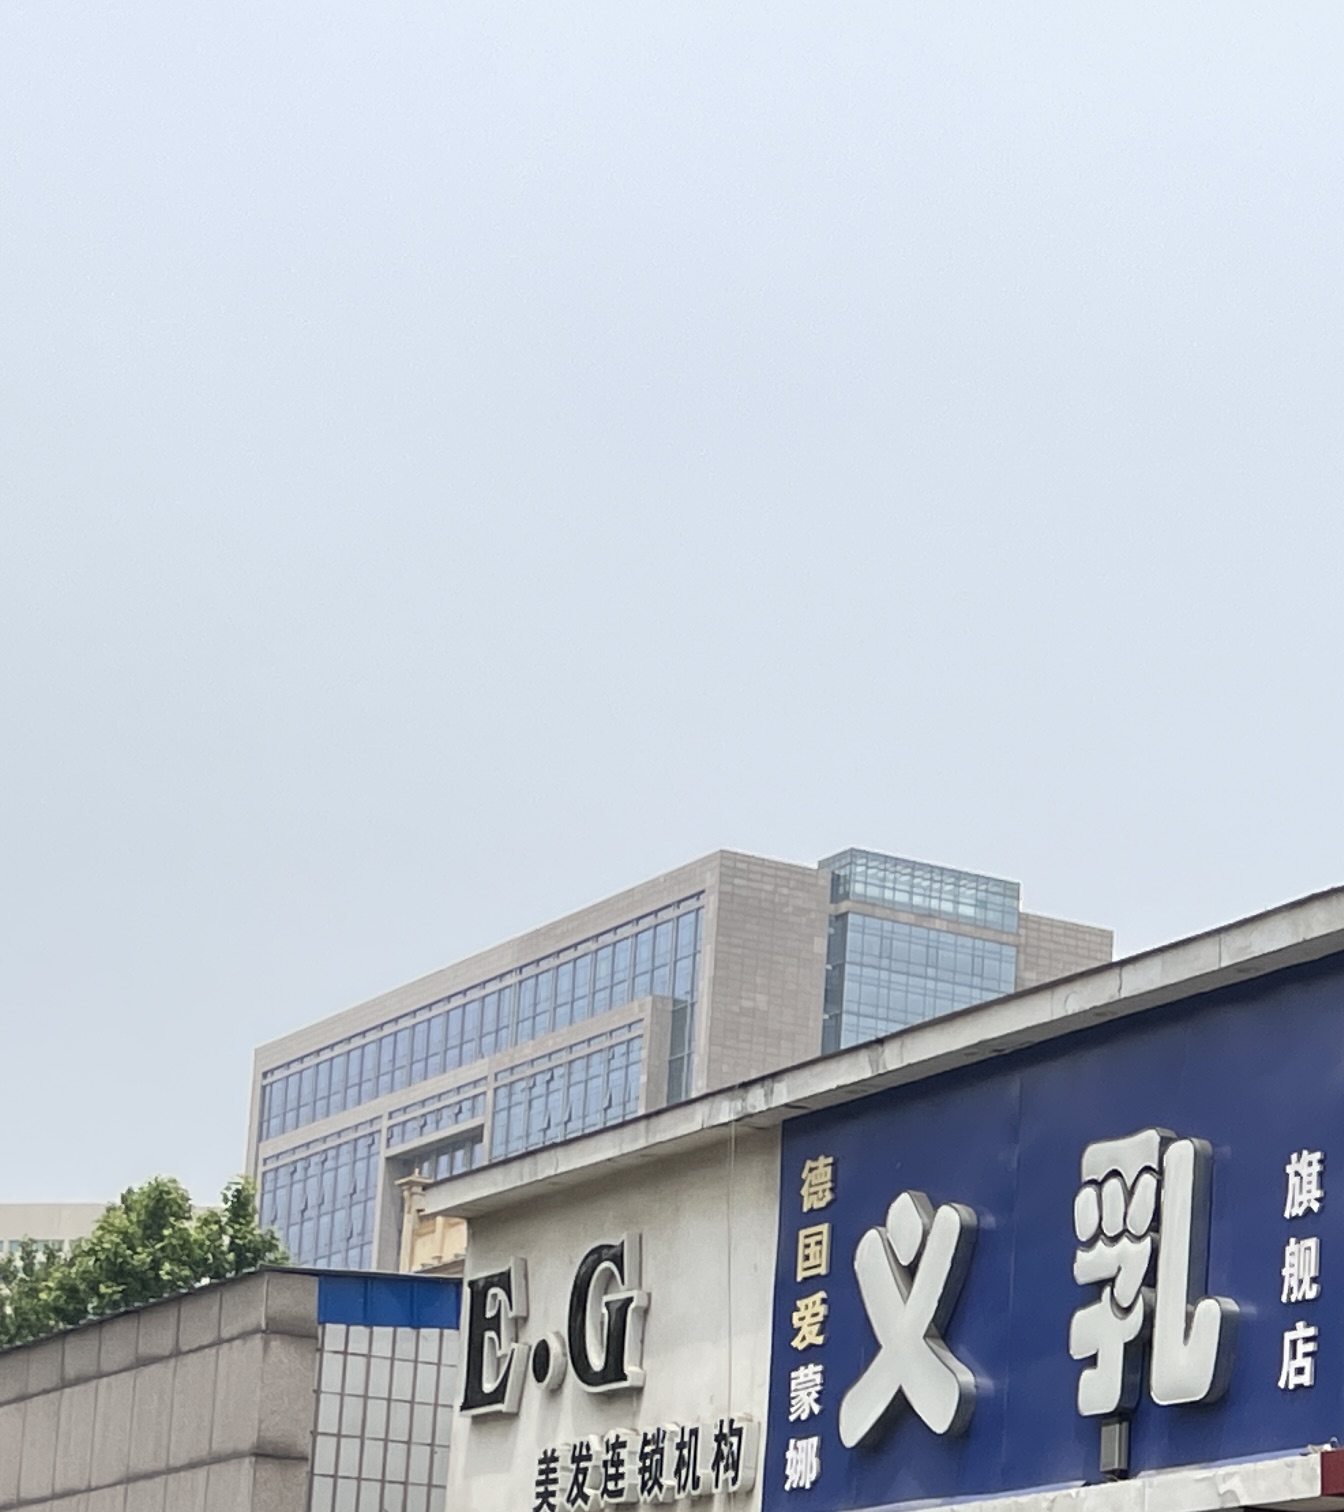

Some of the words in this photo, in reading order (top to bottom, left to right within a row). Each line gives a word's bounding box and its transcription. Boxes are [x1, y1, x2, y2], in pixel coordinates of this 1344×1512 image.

[784, 1155, 835, 1492] 德国爱蒙娜
[839, 1127, 1240, 1449] 义乳
[1278, 1149, 1325, 1391] 旗舰店
